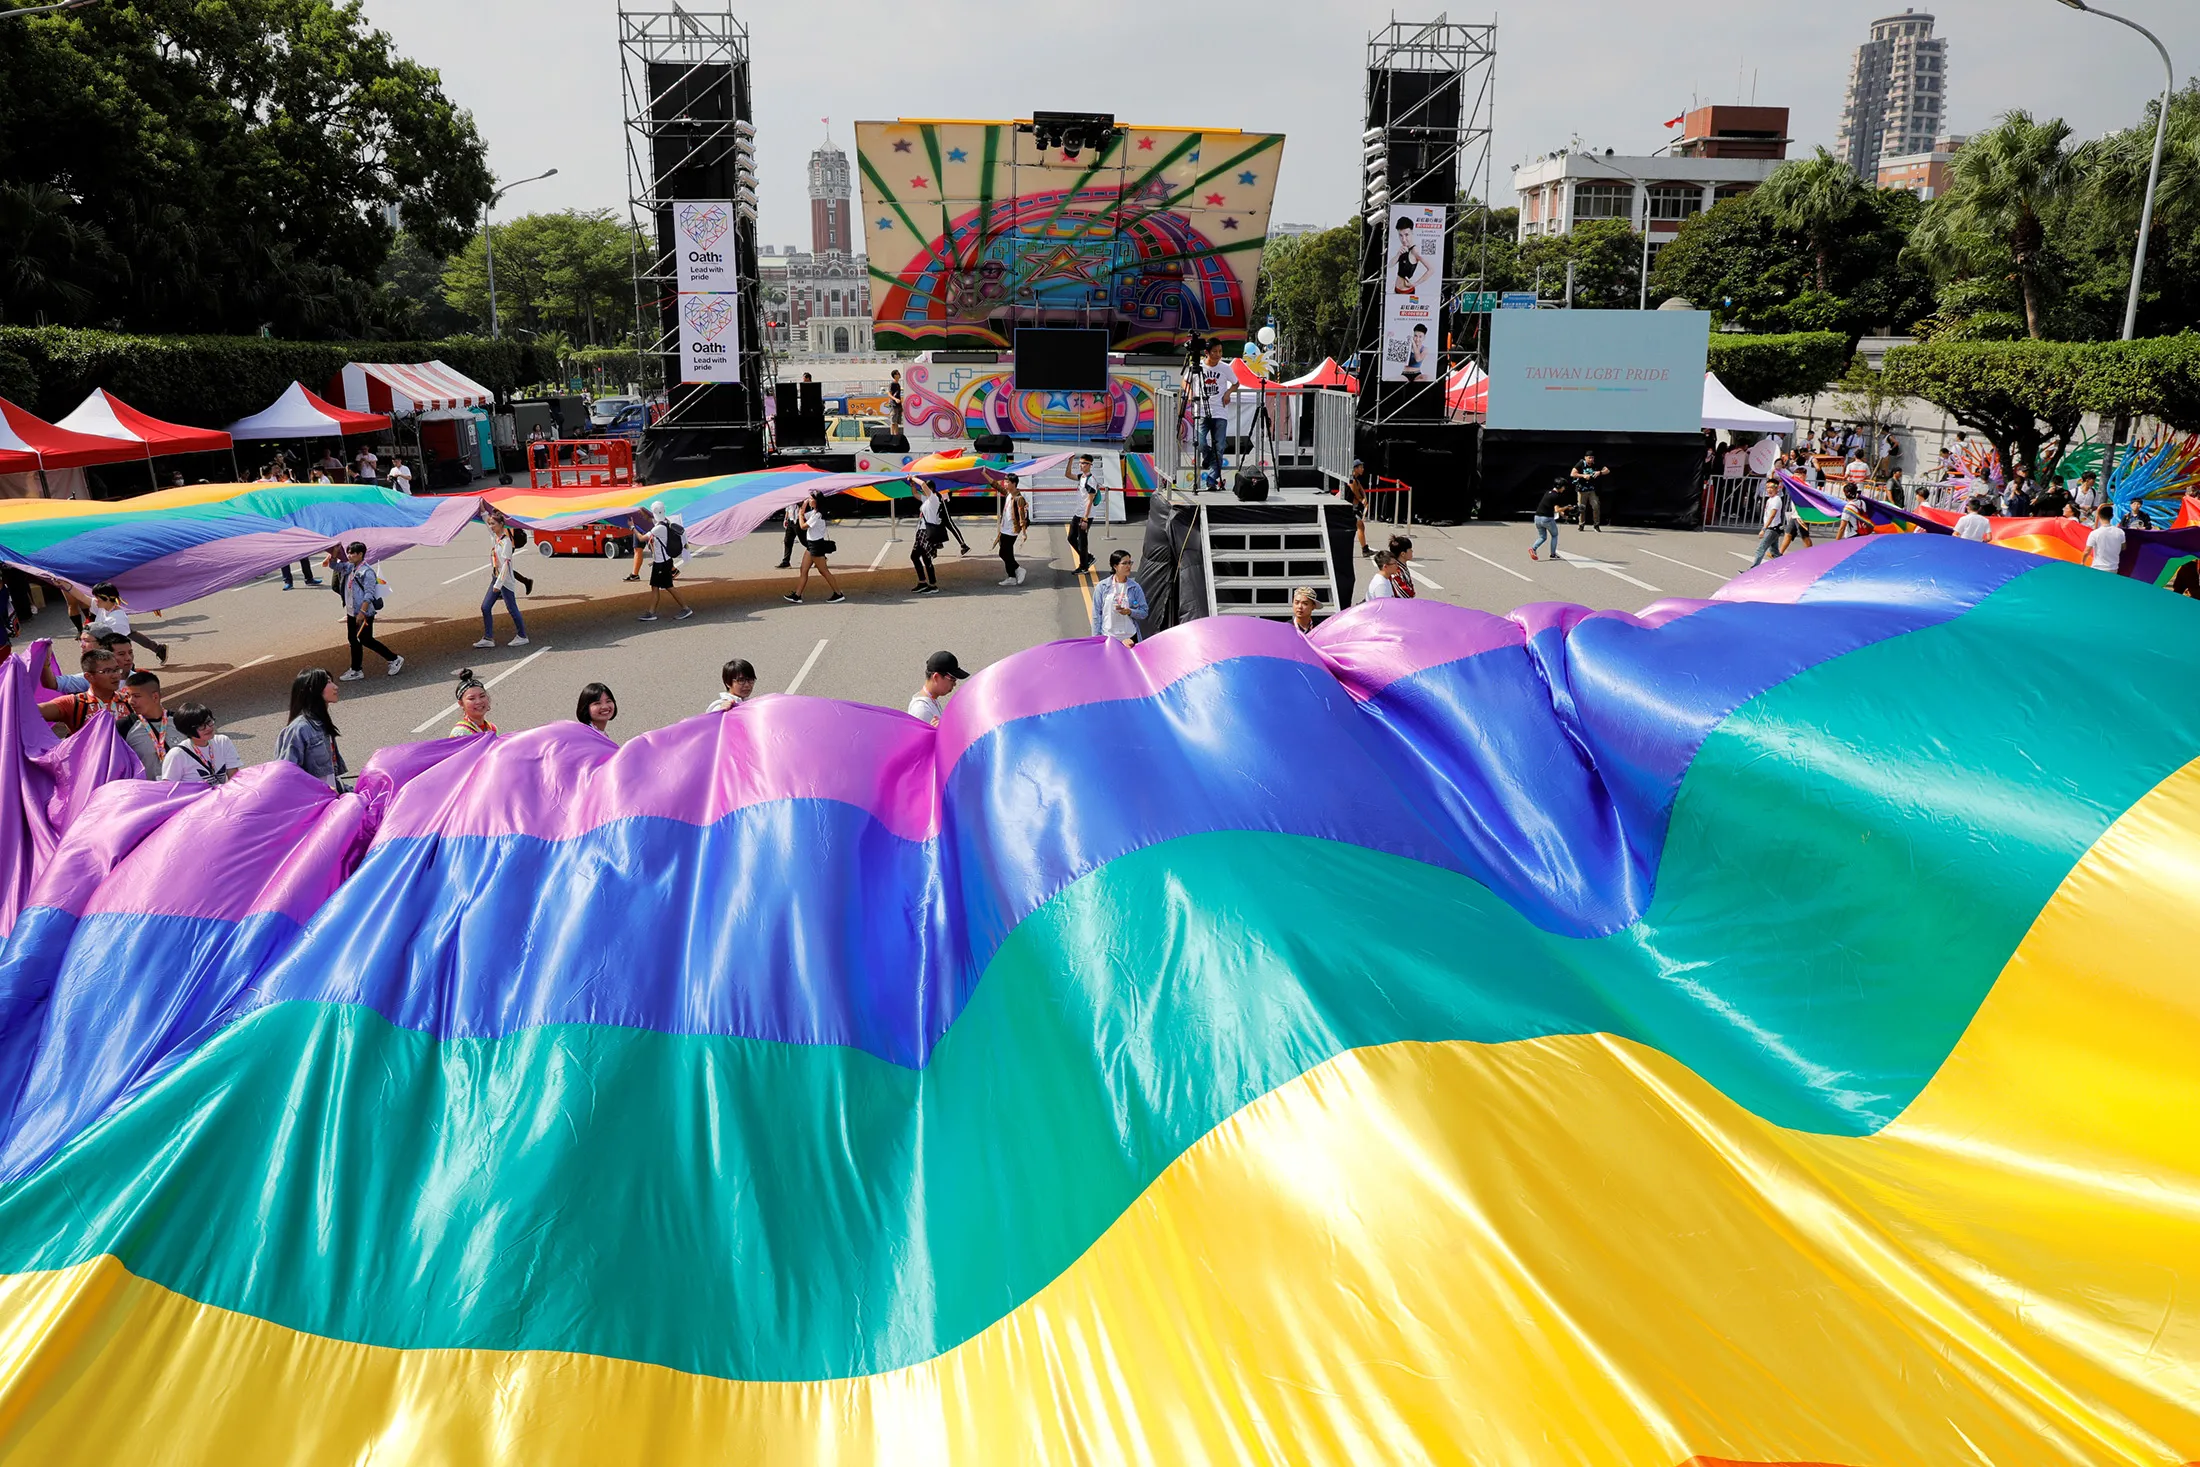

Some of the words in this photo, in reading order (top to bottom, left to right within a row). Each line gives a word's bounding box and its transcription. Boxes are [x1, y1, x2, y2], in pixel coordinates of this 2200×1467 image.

[688, 251, 722, 262] Oath:
[692, 342, 726, 353] Oath:
[1525, 366, 1582, 379] TAIWAN
[1585, 367, 1623, 380] LGBT
[1625, 368, 1670, 381] PRIDE
